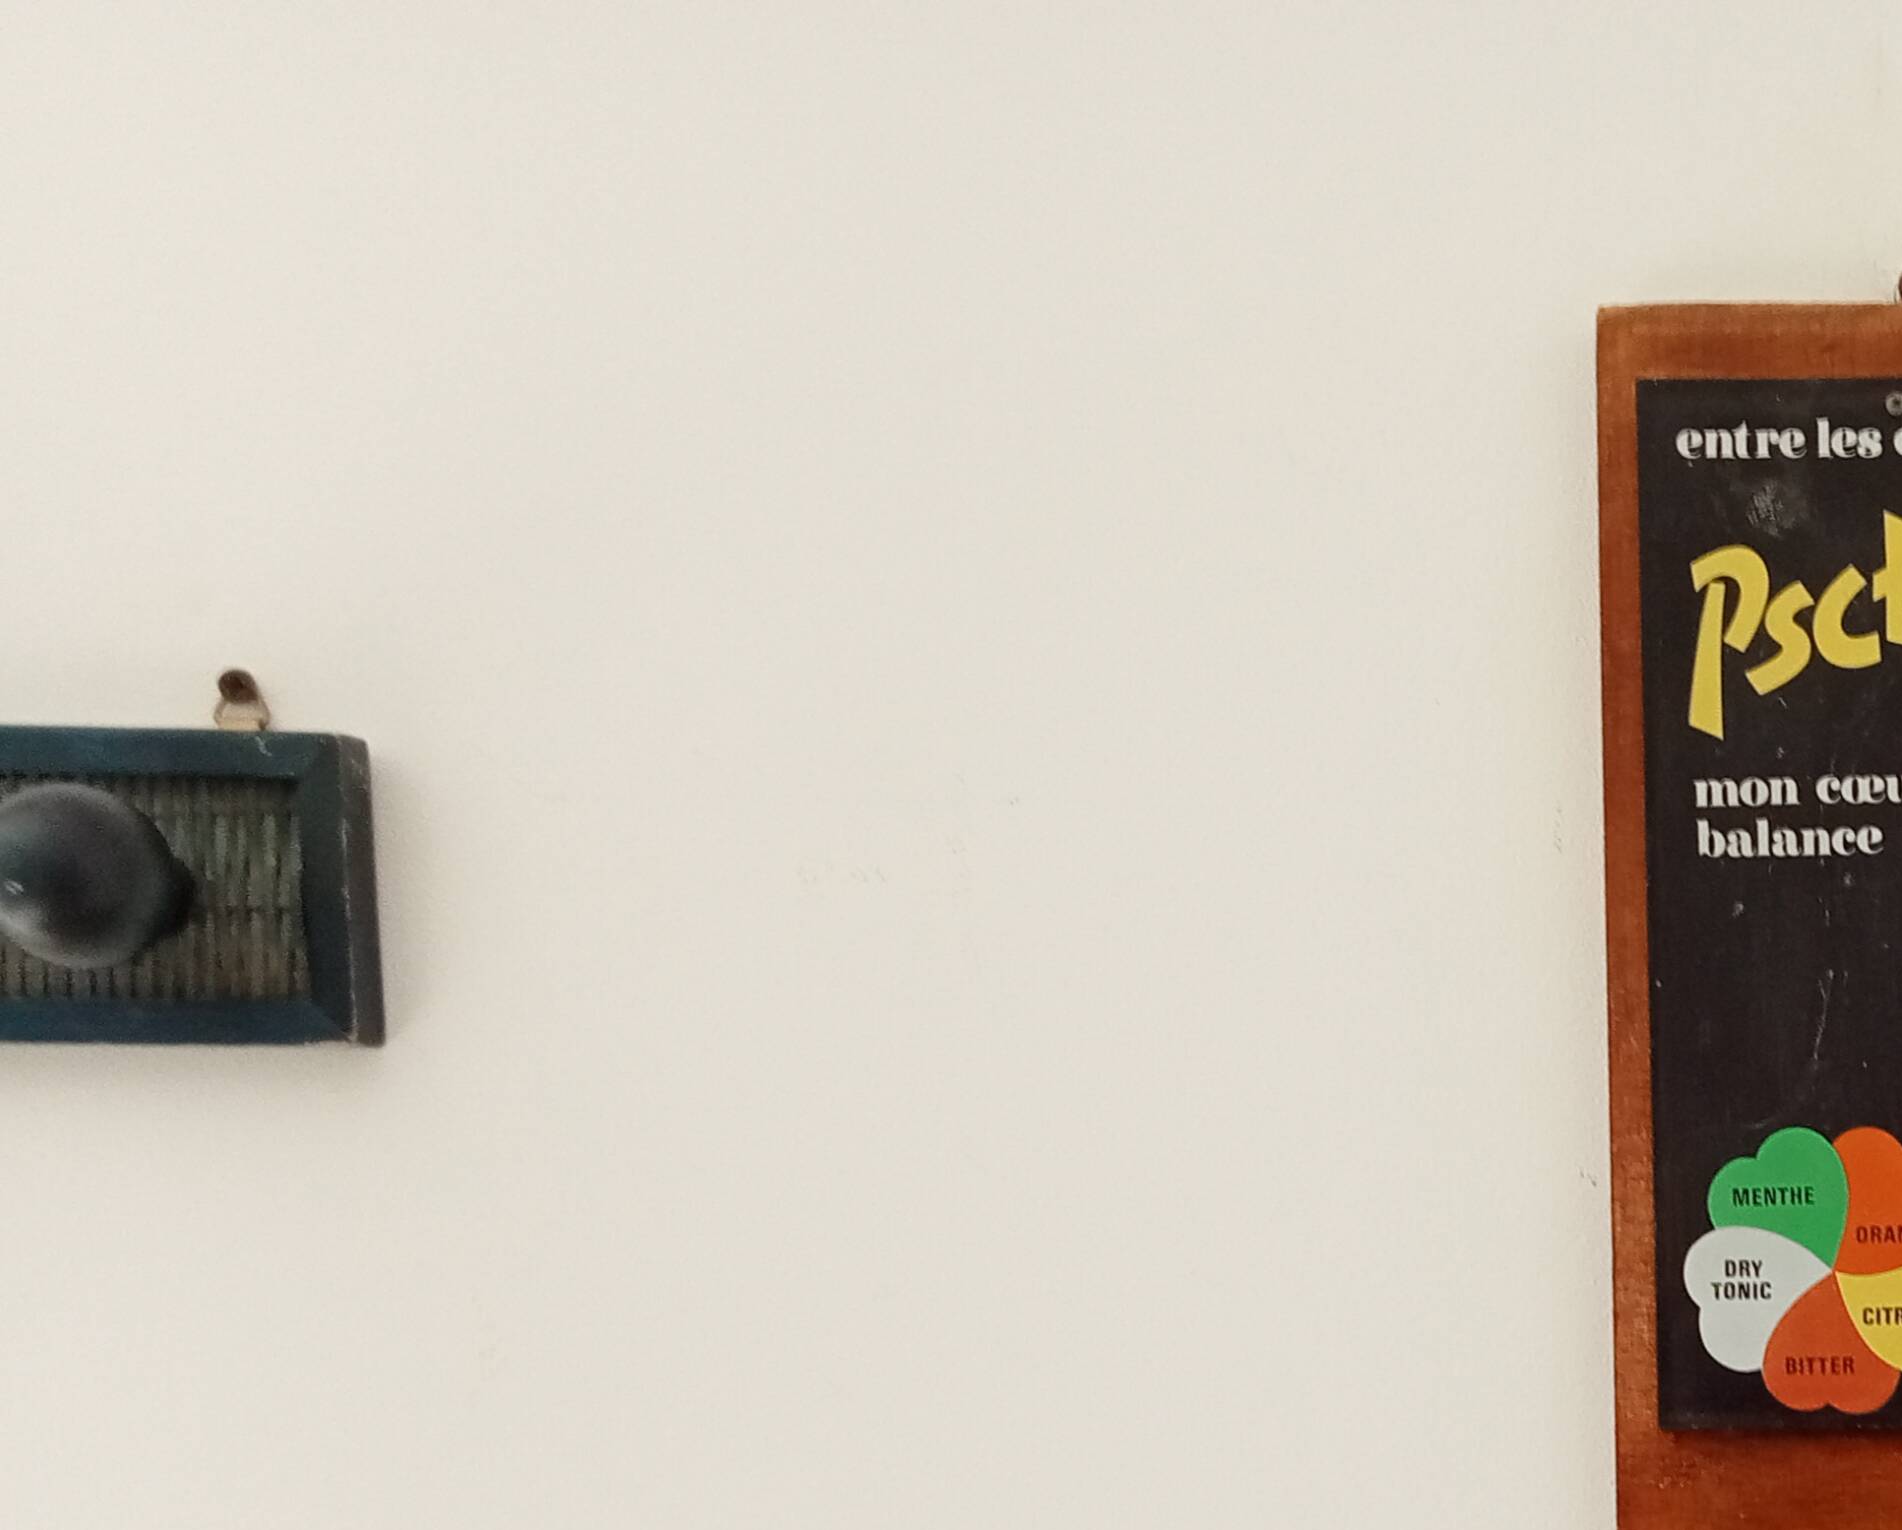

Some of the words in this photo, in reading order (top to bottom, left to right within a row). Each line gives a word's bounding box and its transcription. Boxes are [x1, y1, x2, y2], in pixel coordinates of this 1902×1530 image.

[1676, 420, 1806, 460] entre
[1817, 418, 1882, 459] les
[1695, 776, 1799, 808] mon
[1696, 818, 1884, 858] balance
[1732, 1186, 1815, 1207] MENTHE
[1724, 1259, 1764, 1279] DRY
[1711, 1281, 1772, 1300] TONIC
[1785, 1356, 1856, 1375] BITTER
